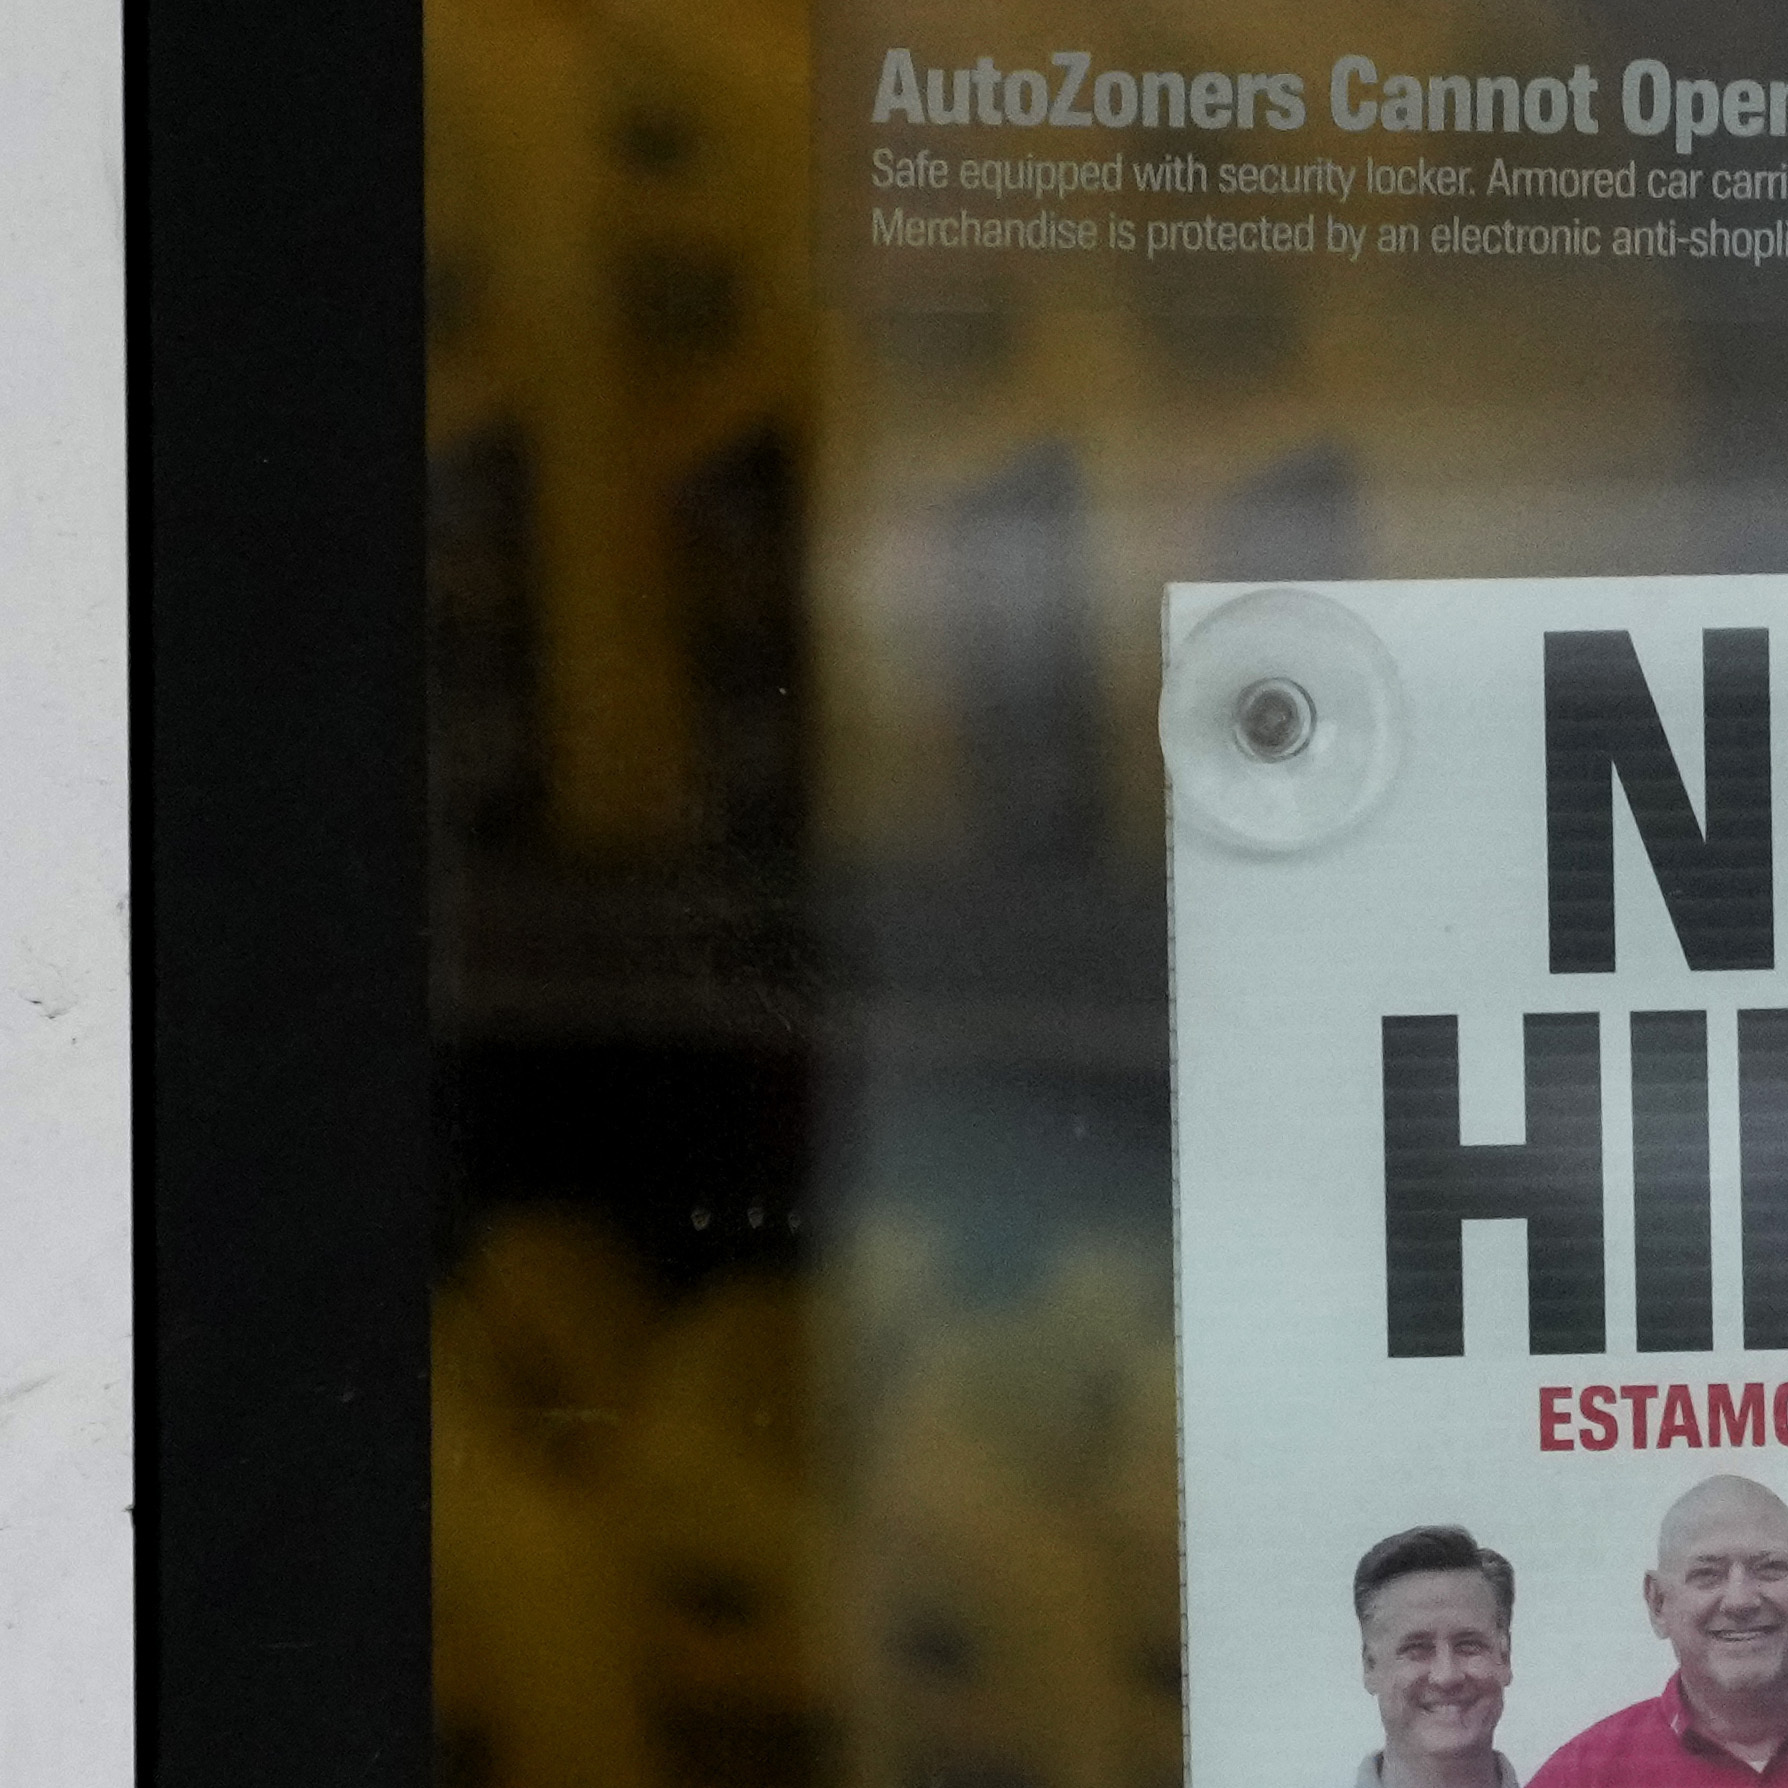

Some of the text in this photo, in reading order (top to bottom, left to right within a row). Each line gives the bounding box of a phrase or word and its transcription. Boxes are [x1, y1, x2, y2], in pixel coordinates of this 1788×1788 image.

[872, 47, 1306, 132] AutoZoners
[1331, 54, 1599, 134] Cannot
[872, 147, 949, 189] Safe
[960, 153, 1123, 199] equipped
[1133, 153, 1207, 193] with
[1219, 156, 1356, 203] security
[1366, 156, 1475, 196] locker.
[1487, 158, 1636, 198] Armored
[1648, 169, 1702, 200] car
[872, 206, 1099, 250] Merchandise
[1110, 212, 1136, 250] is
[1148, 213, 1314, 260] protected
[1327, 213, 1367, 263] by
[1378, 222, 1420, 252] an
[1431, 215, 1600, 256] electronic
